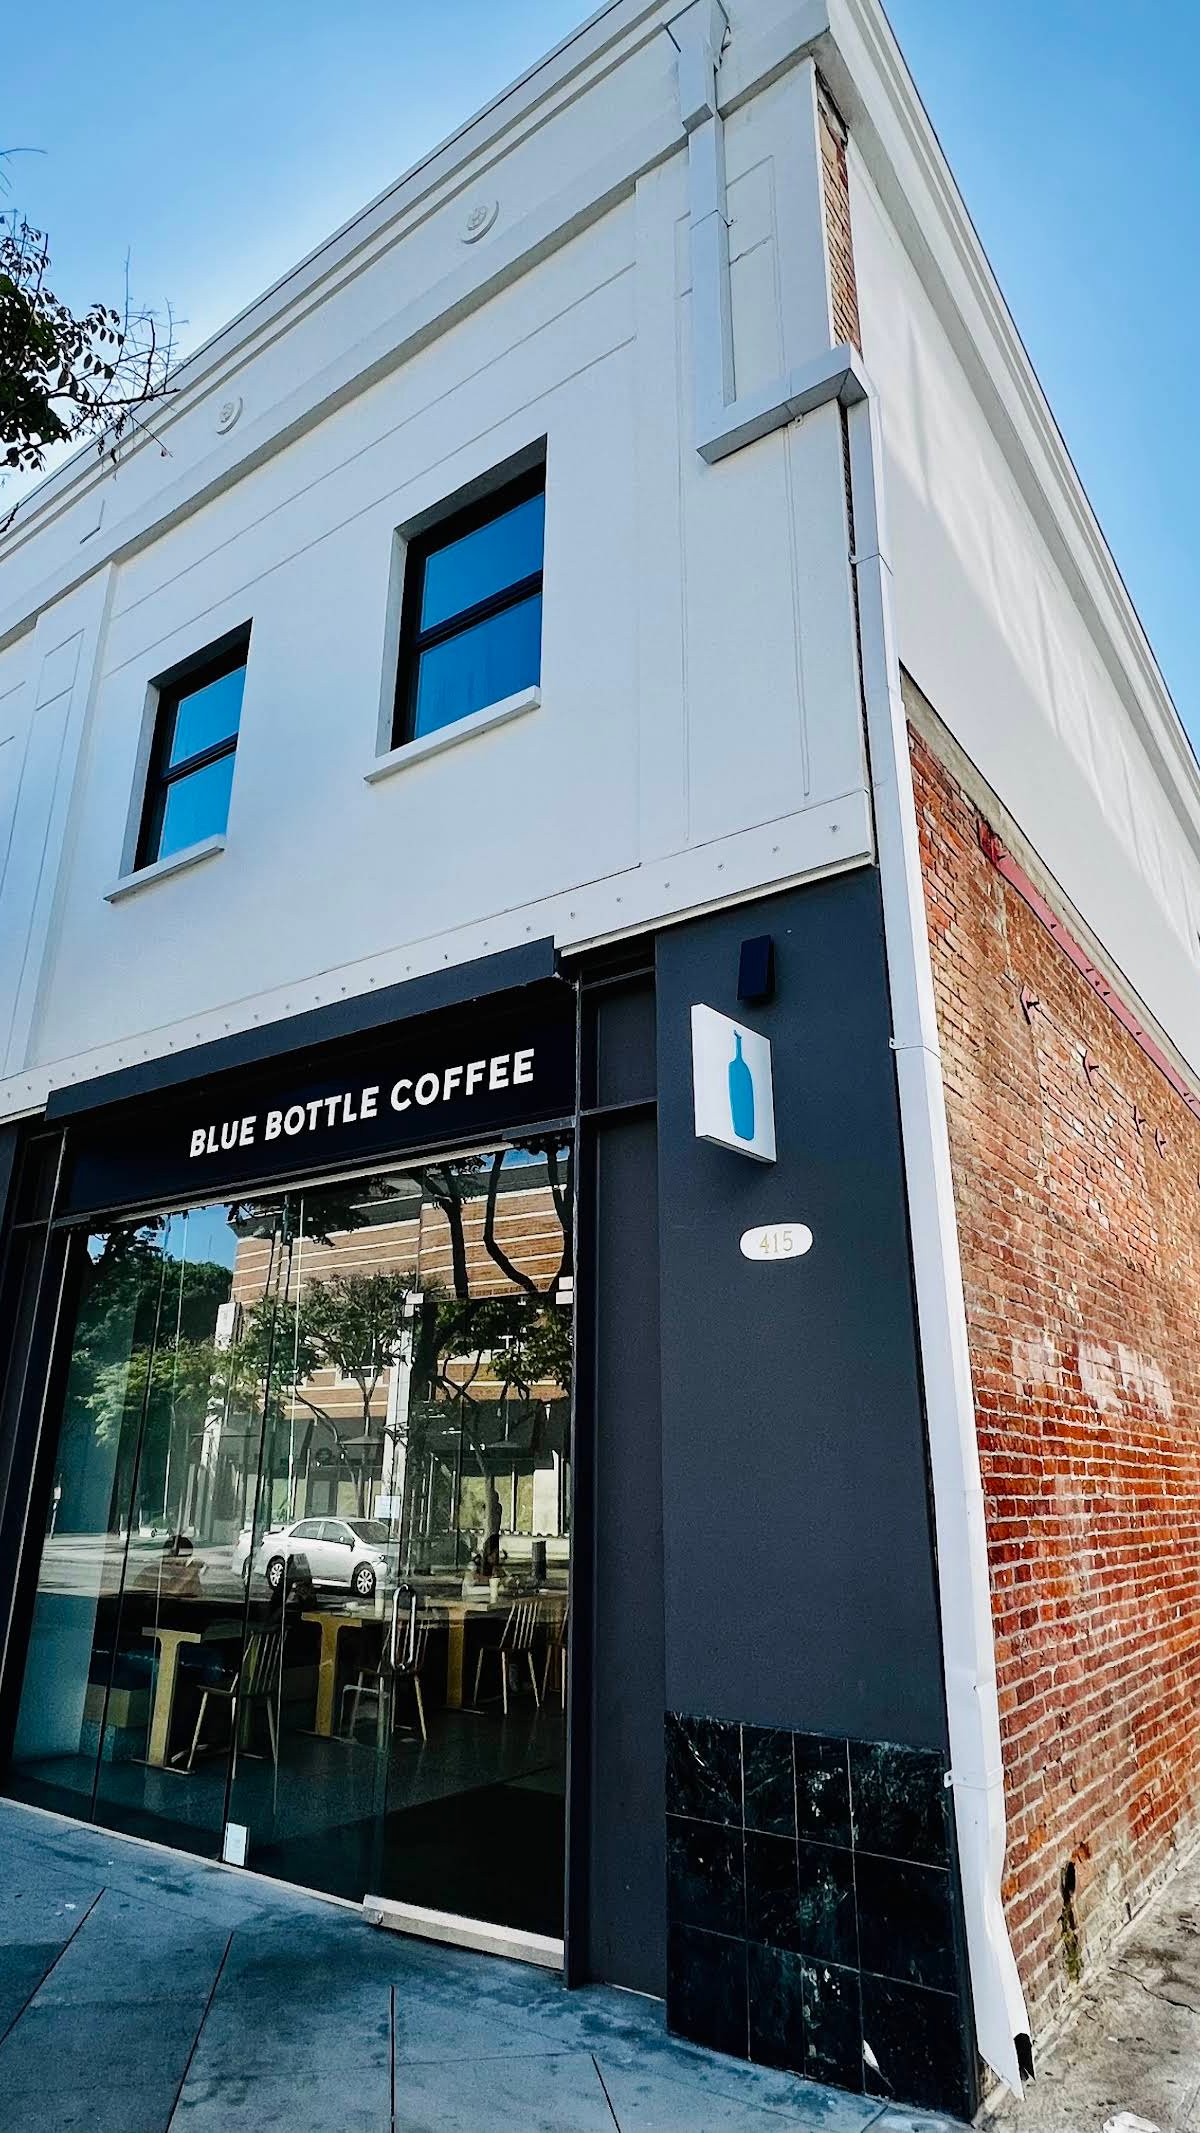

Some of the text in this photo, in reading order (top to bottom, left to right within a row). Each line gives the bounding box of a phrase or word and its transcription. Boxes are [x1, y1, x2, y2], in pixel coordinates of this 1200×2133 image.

[189, 1048, 535, 1157] BLUE BOTTLE COFFEE
[759, 1230, 793, 1254] 415
